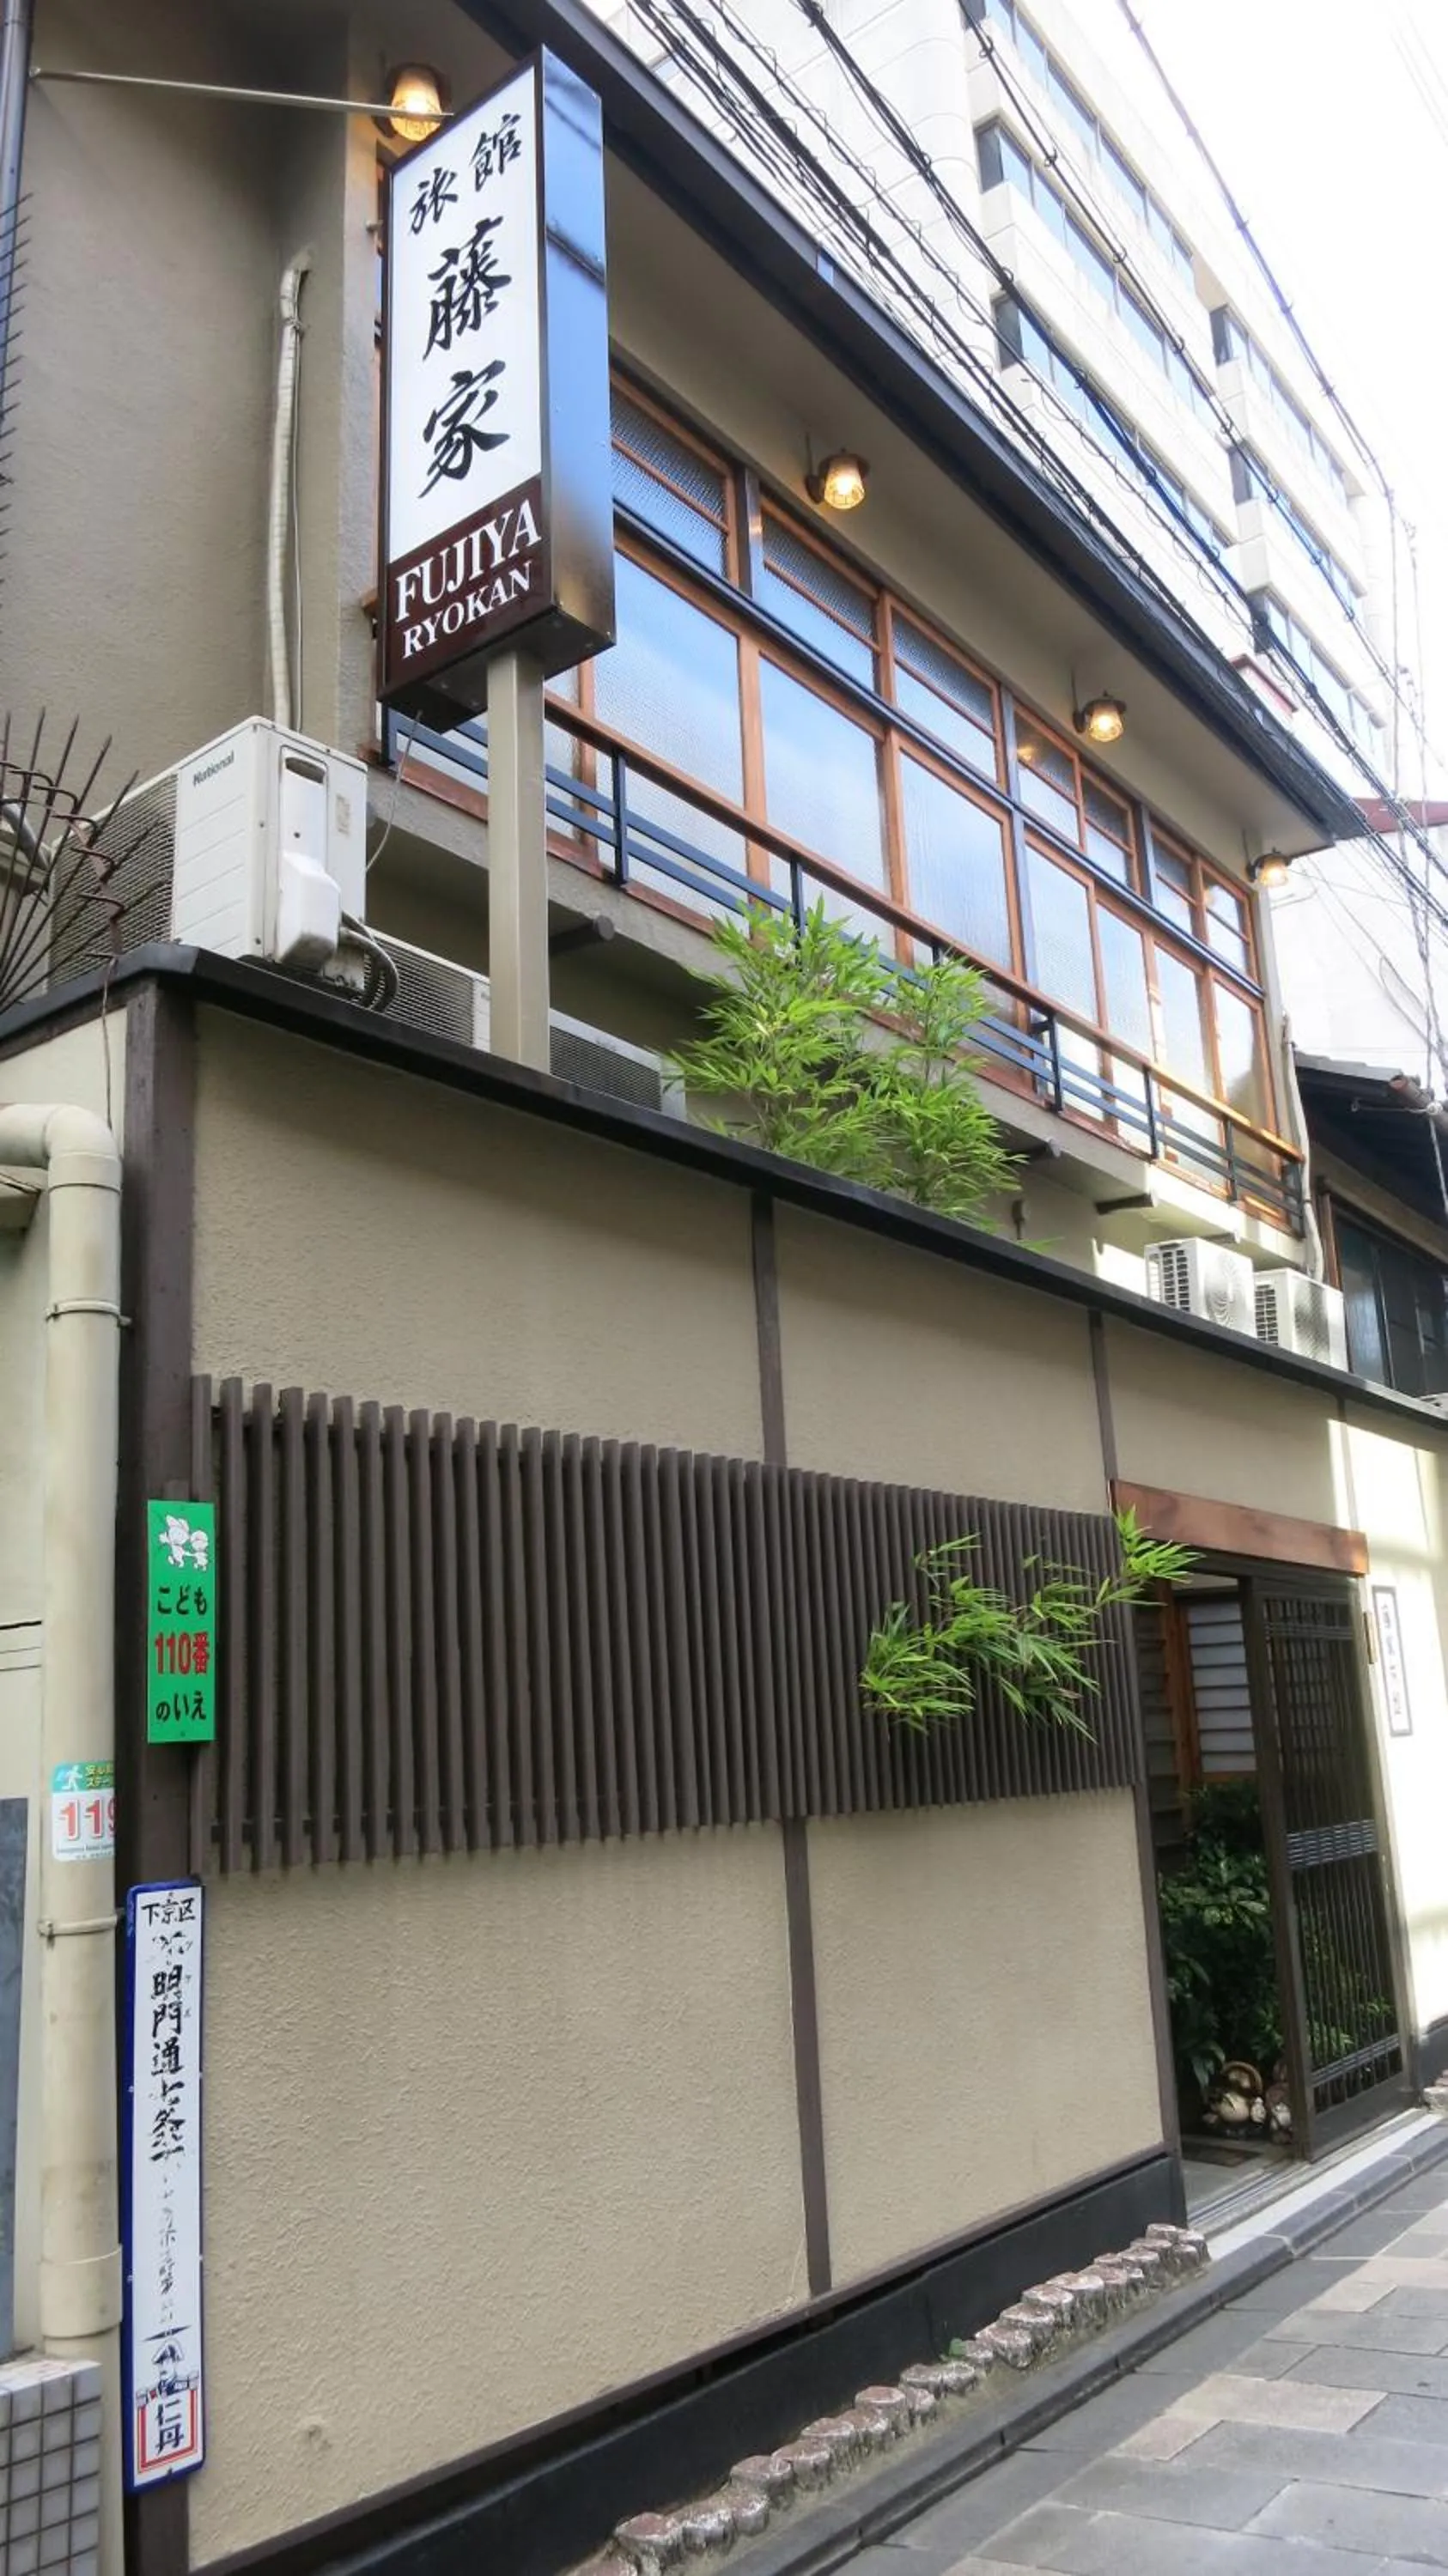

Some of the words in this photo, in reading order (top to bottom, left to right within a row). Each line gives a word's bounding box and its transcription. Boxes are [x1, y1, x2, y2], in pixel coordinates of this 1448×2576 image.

[394, 498, 542, 623] FUJIYA
[402, 562, 532, 659] RYOKAN
[193, 750, 234, 787] National
[157, 1586, 207, 1615] こども
[155, 1632, 210, 1675] 110番
[155, 1691, 206, 1722] のいえ
[155, 2400, 185, 2457] 仁丹
